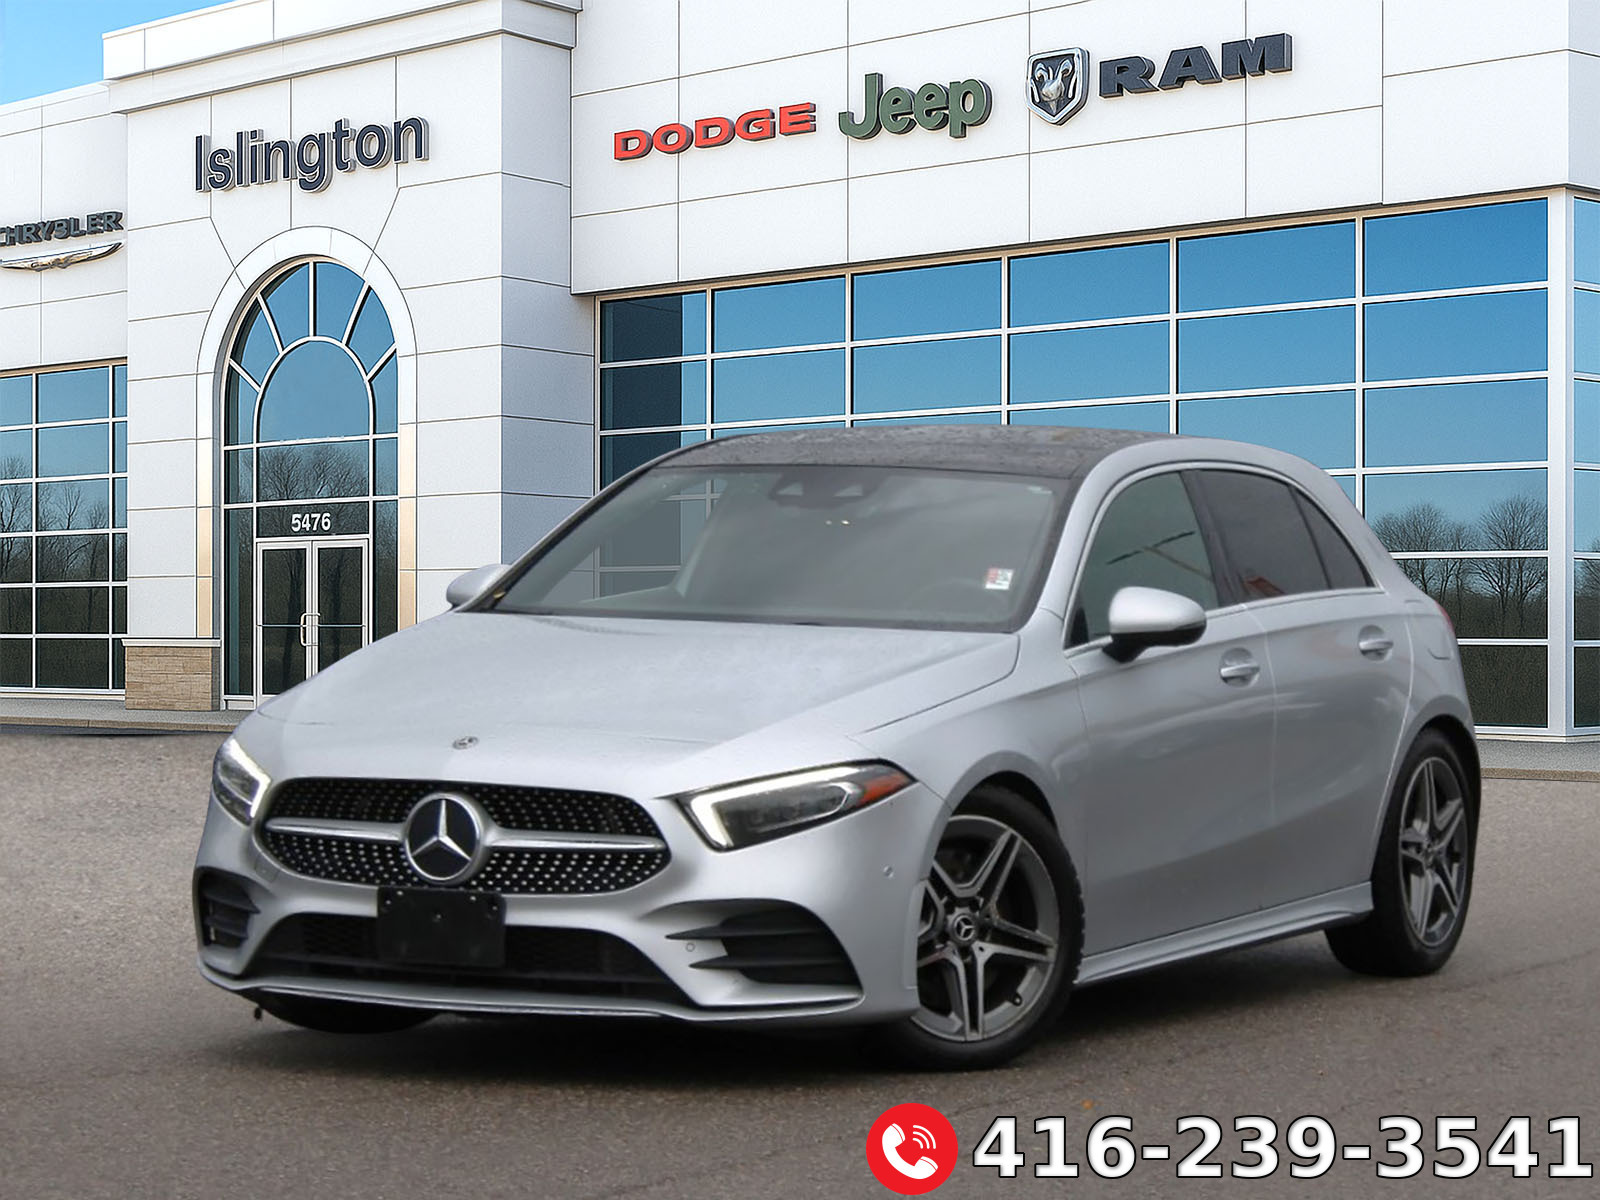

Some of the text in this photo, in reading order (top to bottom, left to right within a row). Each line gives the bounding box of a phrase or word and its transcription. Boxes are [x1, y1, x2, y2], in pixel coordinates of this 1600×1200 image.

[614, 33, 1293, 161] DODGE Jeep RAM
[194, 115, 429, 193] Islington
[291, 512, 331, 532] 5476
